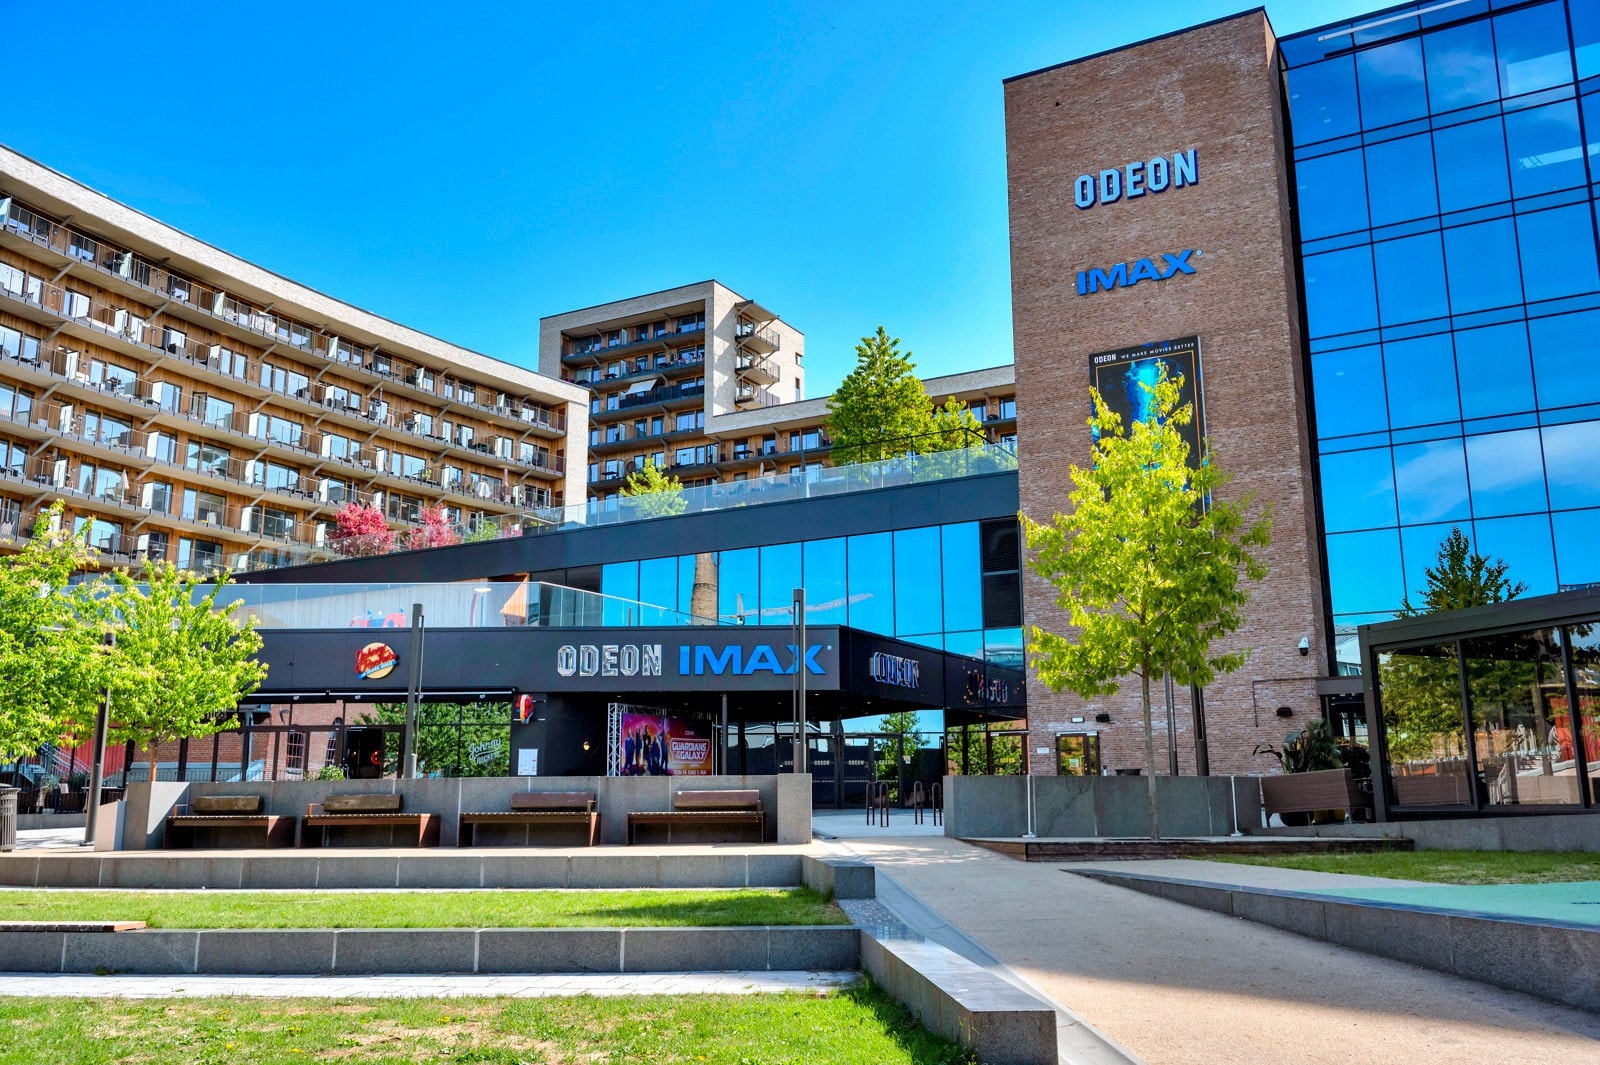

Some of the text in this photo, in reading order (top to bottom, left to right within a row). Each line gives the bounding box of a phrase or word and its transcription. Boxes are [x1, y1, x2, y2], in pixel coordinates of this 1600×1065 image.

[1074, 148, 1199, 210] ODEON
[1077, 249, 1197, 295] IMAX
[1094, 353, 1117, 364] ODEON
[1149, 346, 1172, 354] MOVIES
[1173, 342, 1195, 350] BETTER
[557, 644, 827, 677] ODEON IMAX
[871, 651, 920, 689] ODEON
[469, 738, 502, 760] Johnny
[672, 741, 707, 752] GUARDIANS
[680, 751, 706, 760] GALAXY
